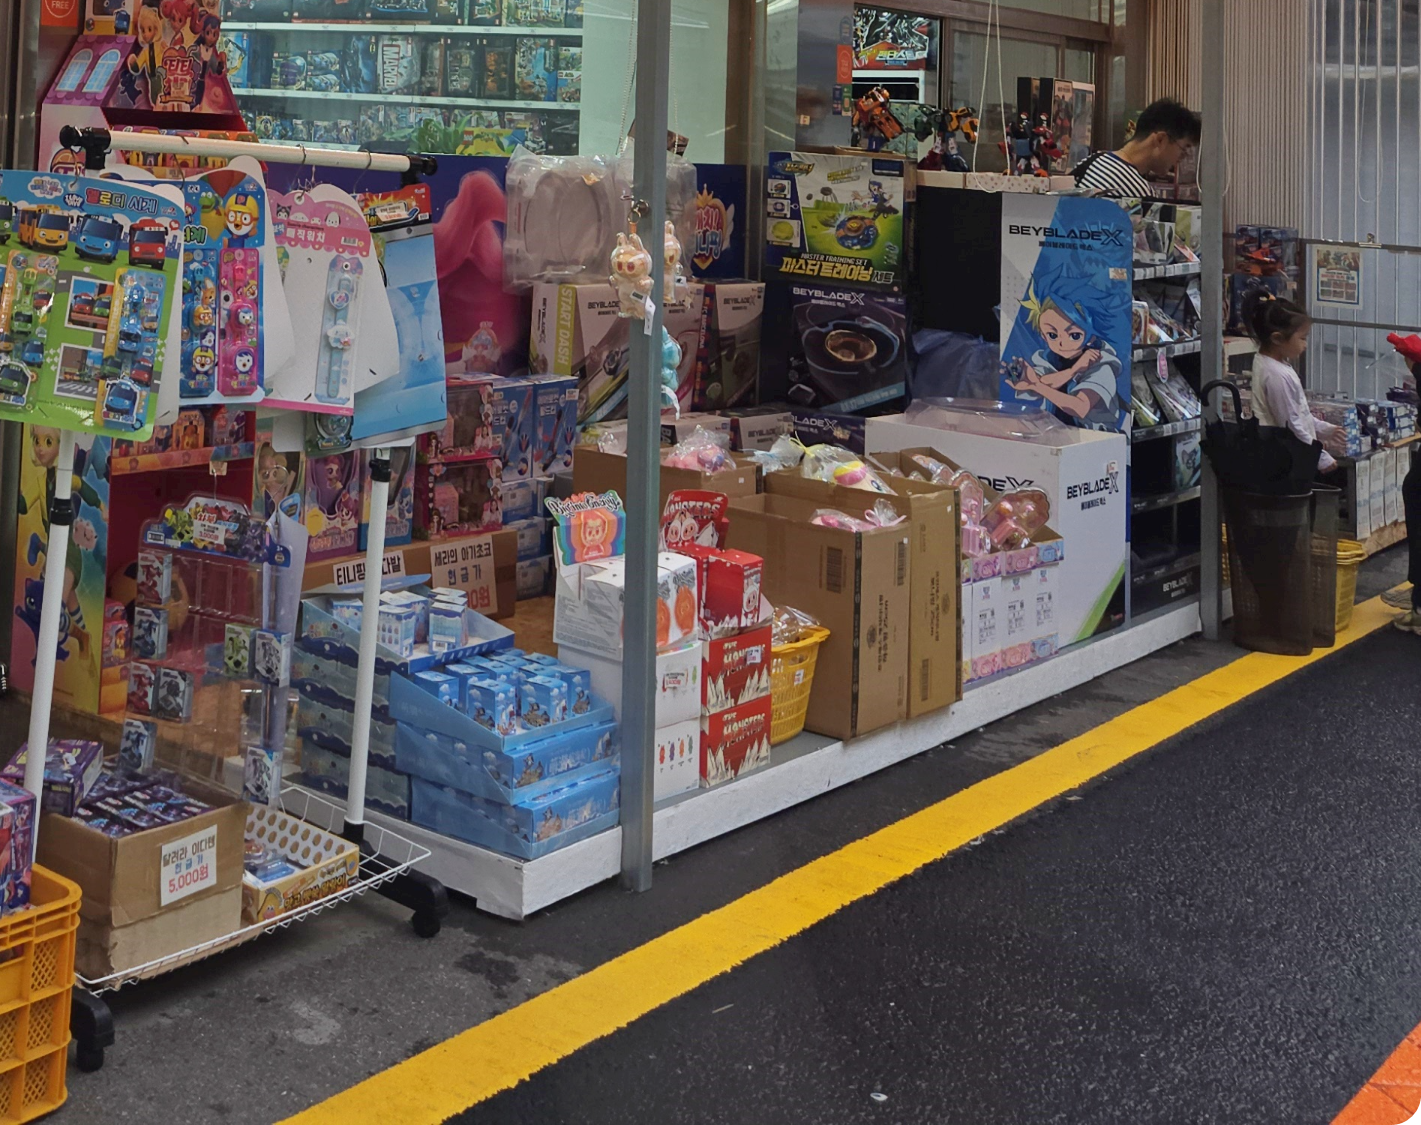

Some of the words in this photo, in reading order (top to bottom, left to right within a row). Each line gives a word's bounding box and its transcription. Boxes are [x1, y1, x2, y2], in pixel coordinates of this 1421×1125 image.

[51, 0, 70, 9] FREE
[381, 44, 399, 88] MARVEL
[128, 195, 158, 213] 시계
[779, 257, 819, 276] 마스터
[820, 262, 873, 282] 트레이닝
[559, 287, 575, 320] START
[556, 322, 573, 367] DASH
[381, 555, 401, 576] 다발
[434, 547, 458, 567] 세라의
[461, 542, 492, 561] 아기초코
